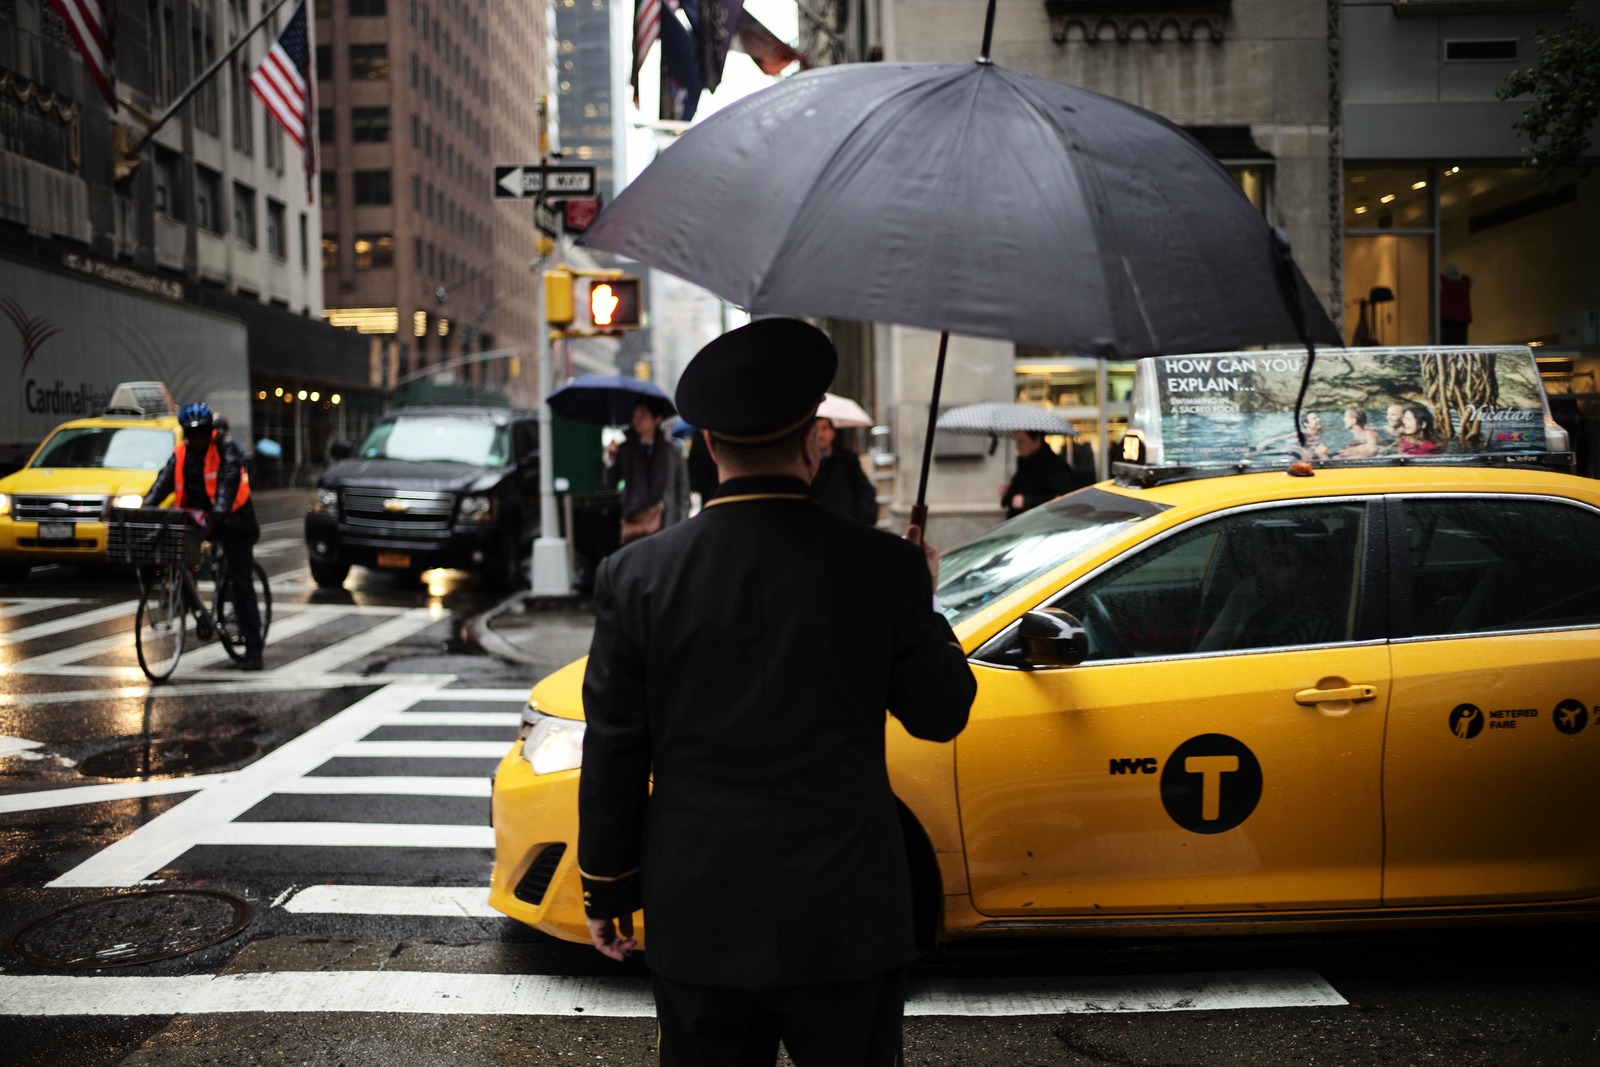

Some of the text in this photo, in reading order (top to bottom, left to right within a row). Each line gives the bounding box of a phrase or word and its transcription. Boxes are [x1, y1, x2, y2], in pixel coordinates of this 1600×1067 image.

[1165, 358, 1300, 373] HOW CAN YOU
[1167, 377, 1255, 392] EXPLAIN...
[1170, 397, 1230, 406] SWIMMING IN
[1171, 406, 1178, 414] A
[1179, 405, 1211, 414] SACRED
[1490, 709, 1537, 719] METERED
[1490, 721, 1517, 729] FARE
[1110, 755, 1239, 821] NYC T
